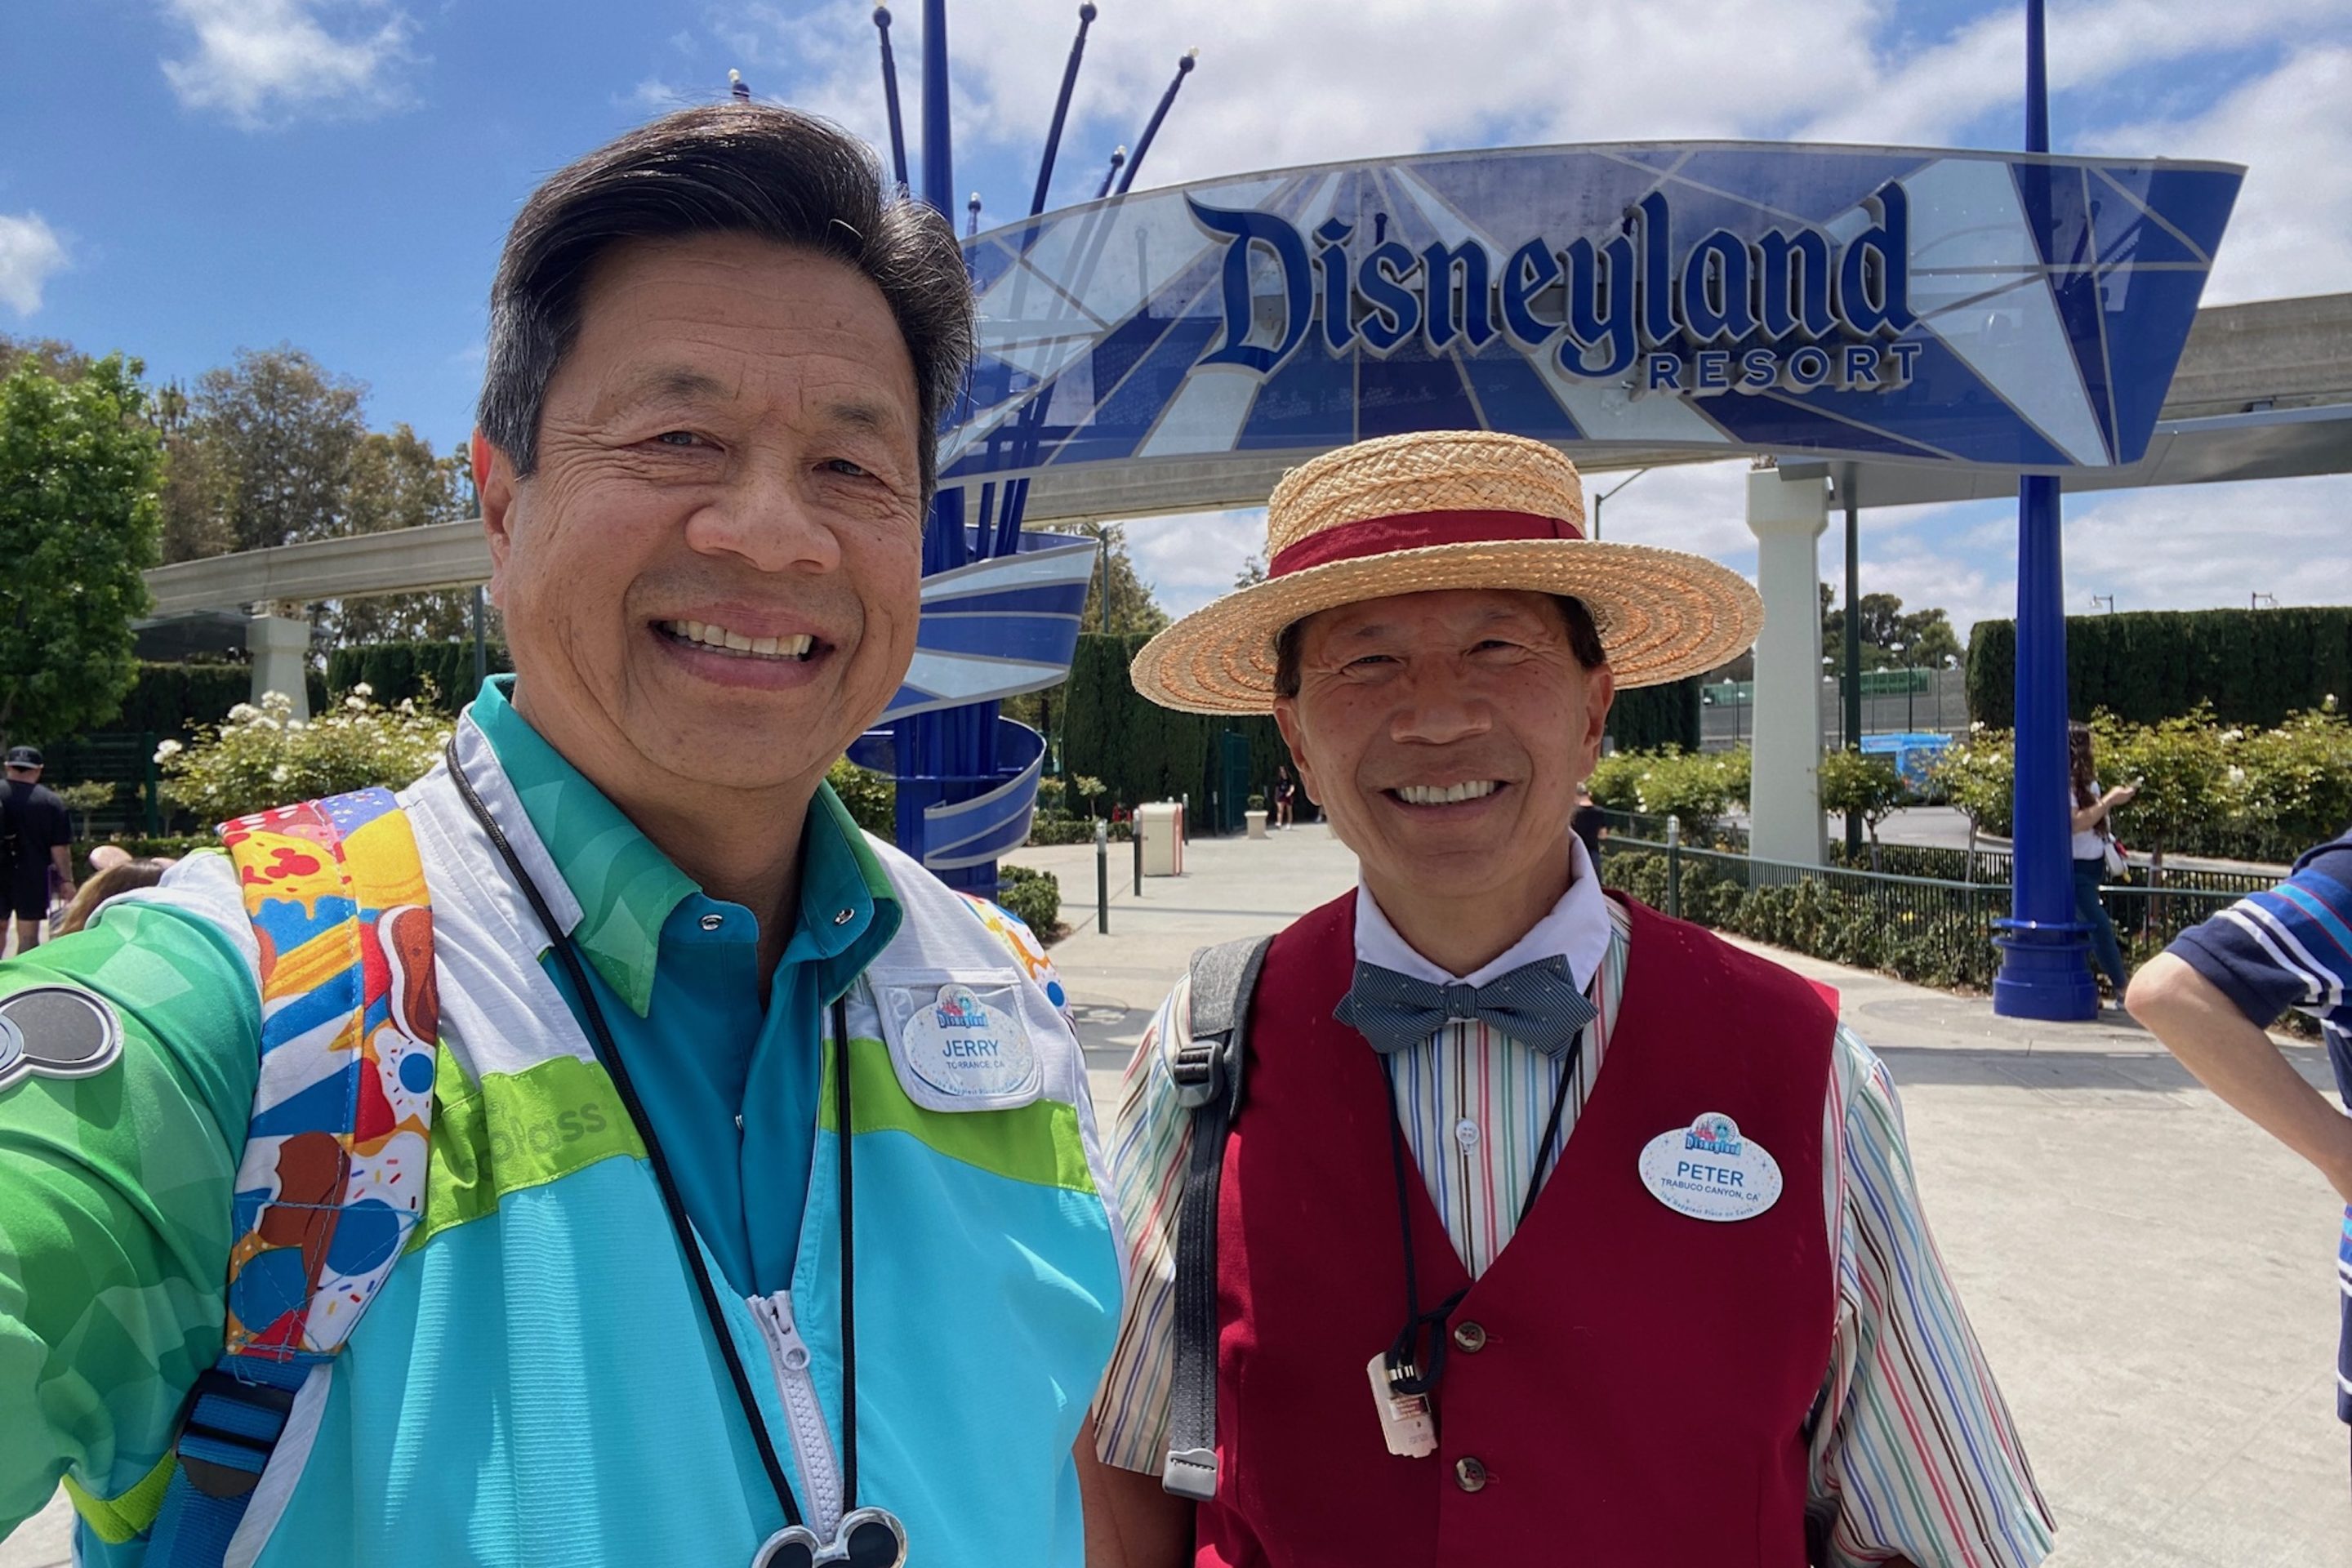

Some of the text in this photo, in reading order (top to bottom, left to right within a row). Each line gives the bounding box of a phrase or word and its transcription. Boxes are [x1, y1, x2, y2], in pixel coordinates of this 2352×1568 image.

[1182, 176, 1922, 385] Disneyland
[1645, 342, 1923, 392] RESORT
[942, 1039, 999, 1058] JERRY
[1677, 1160, 1744, 1187] PETER
[1660, 1178, 1759, 1202] TRABUCO CANYON, CA
